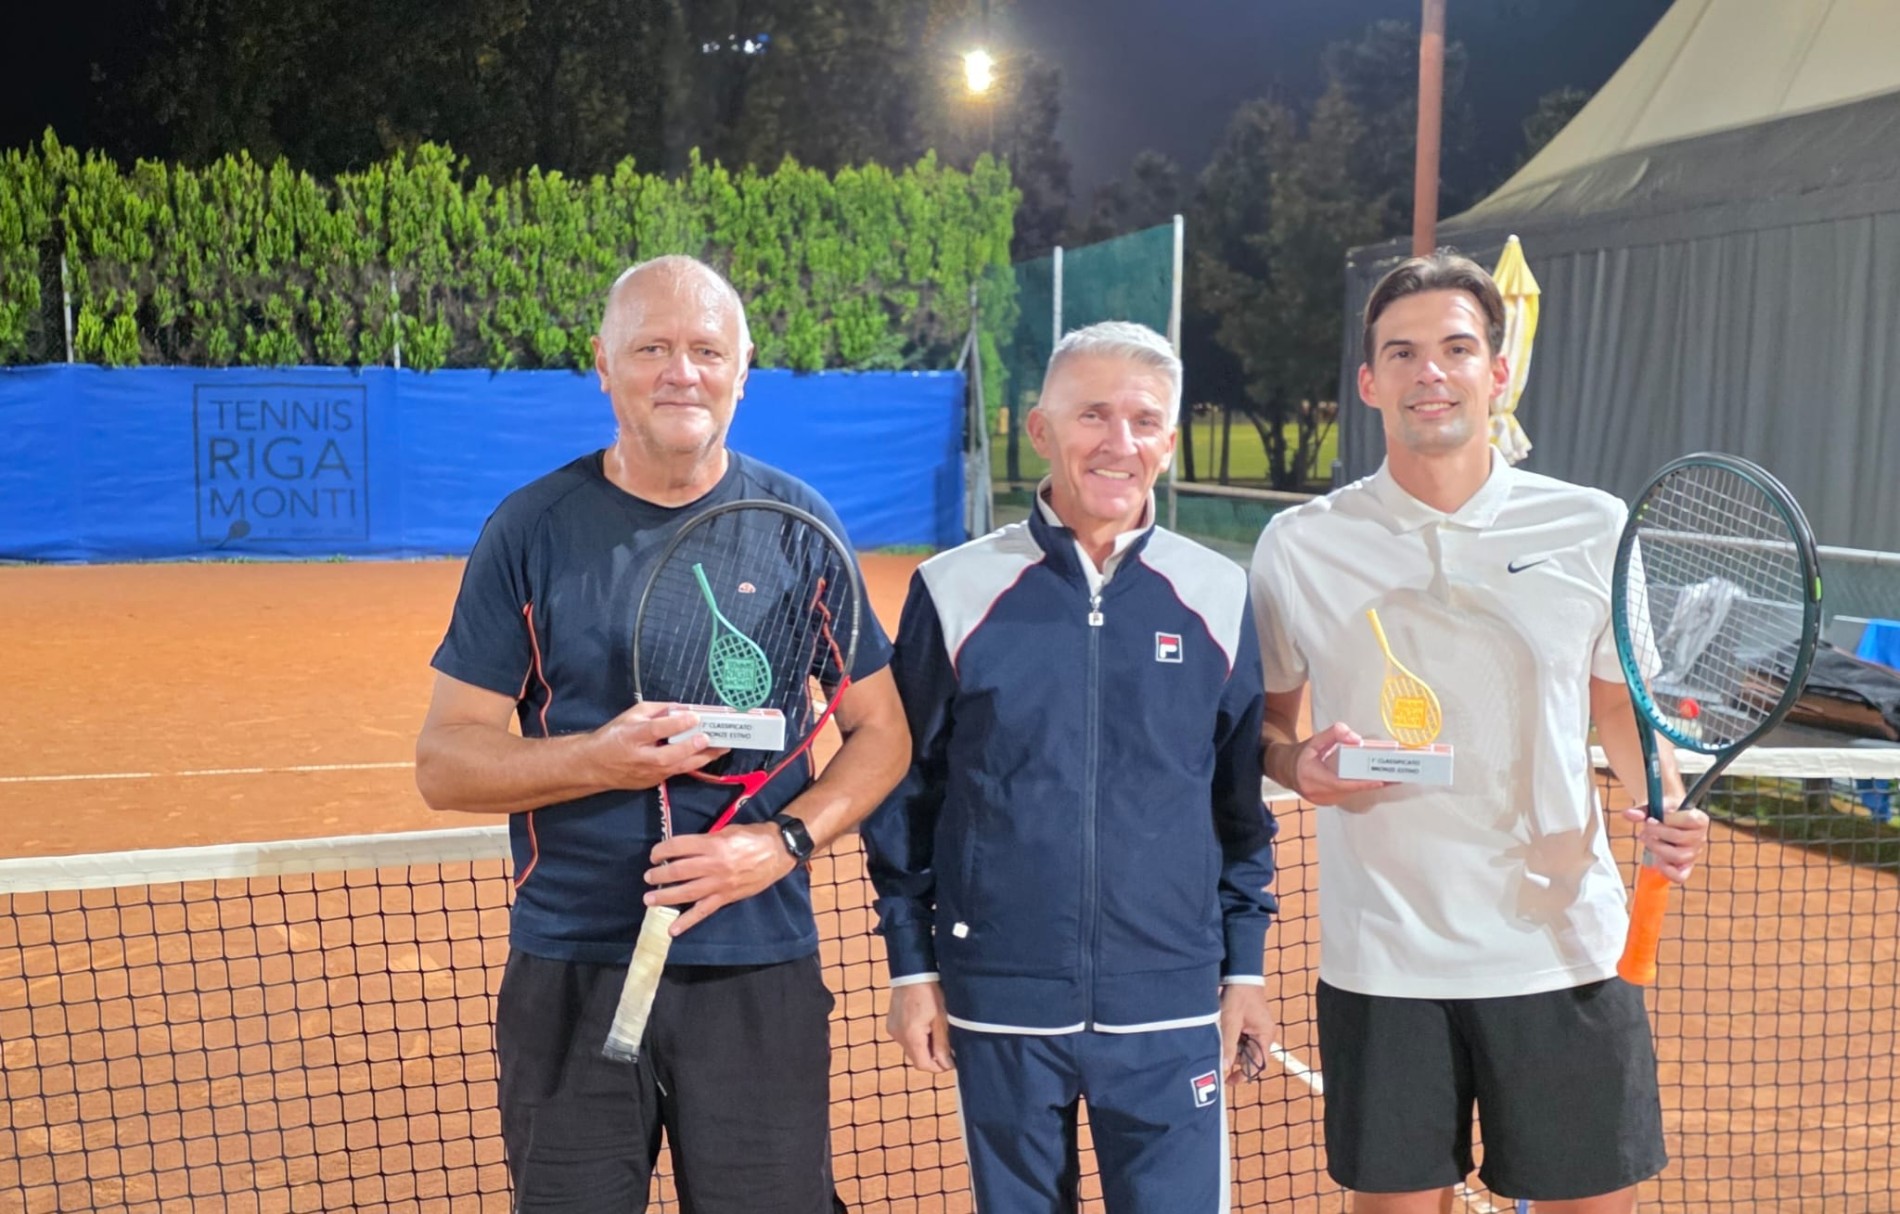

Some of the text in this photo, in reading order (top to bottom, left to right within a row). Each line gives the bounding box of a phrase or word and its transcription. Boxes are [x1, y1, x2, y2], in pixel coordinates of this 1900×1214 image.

[209, 400, 353, 431] TENNIS
[209, 436, 352, 480] RIGA
[210, 486, 356, 518] MONTI
